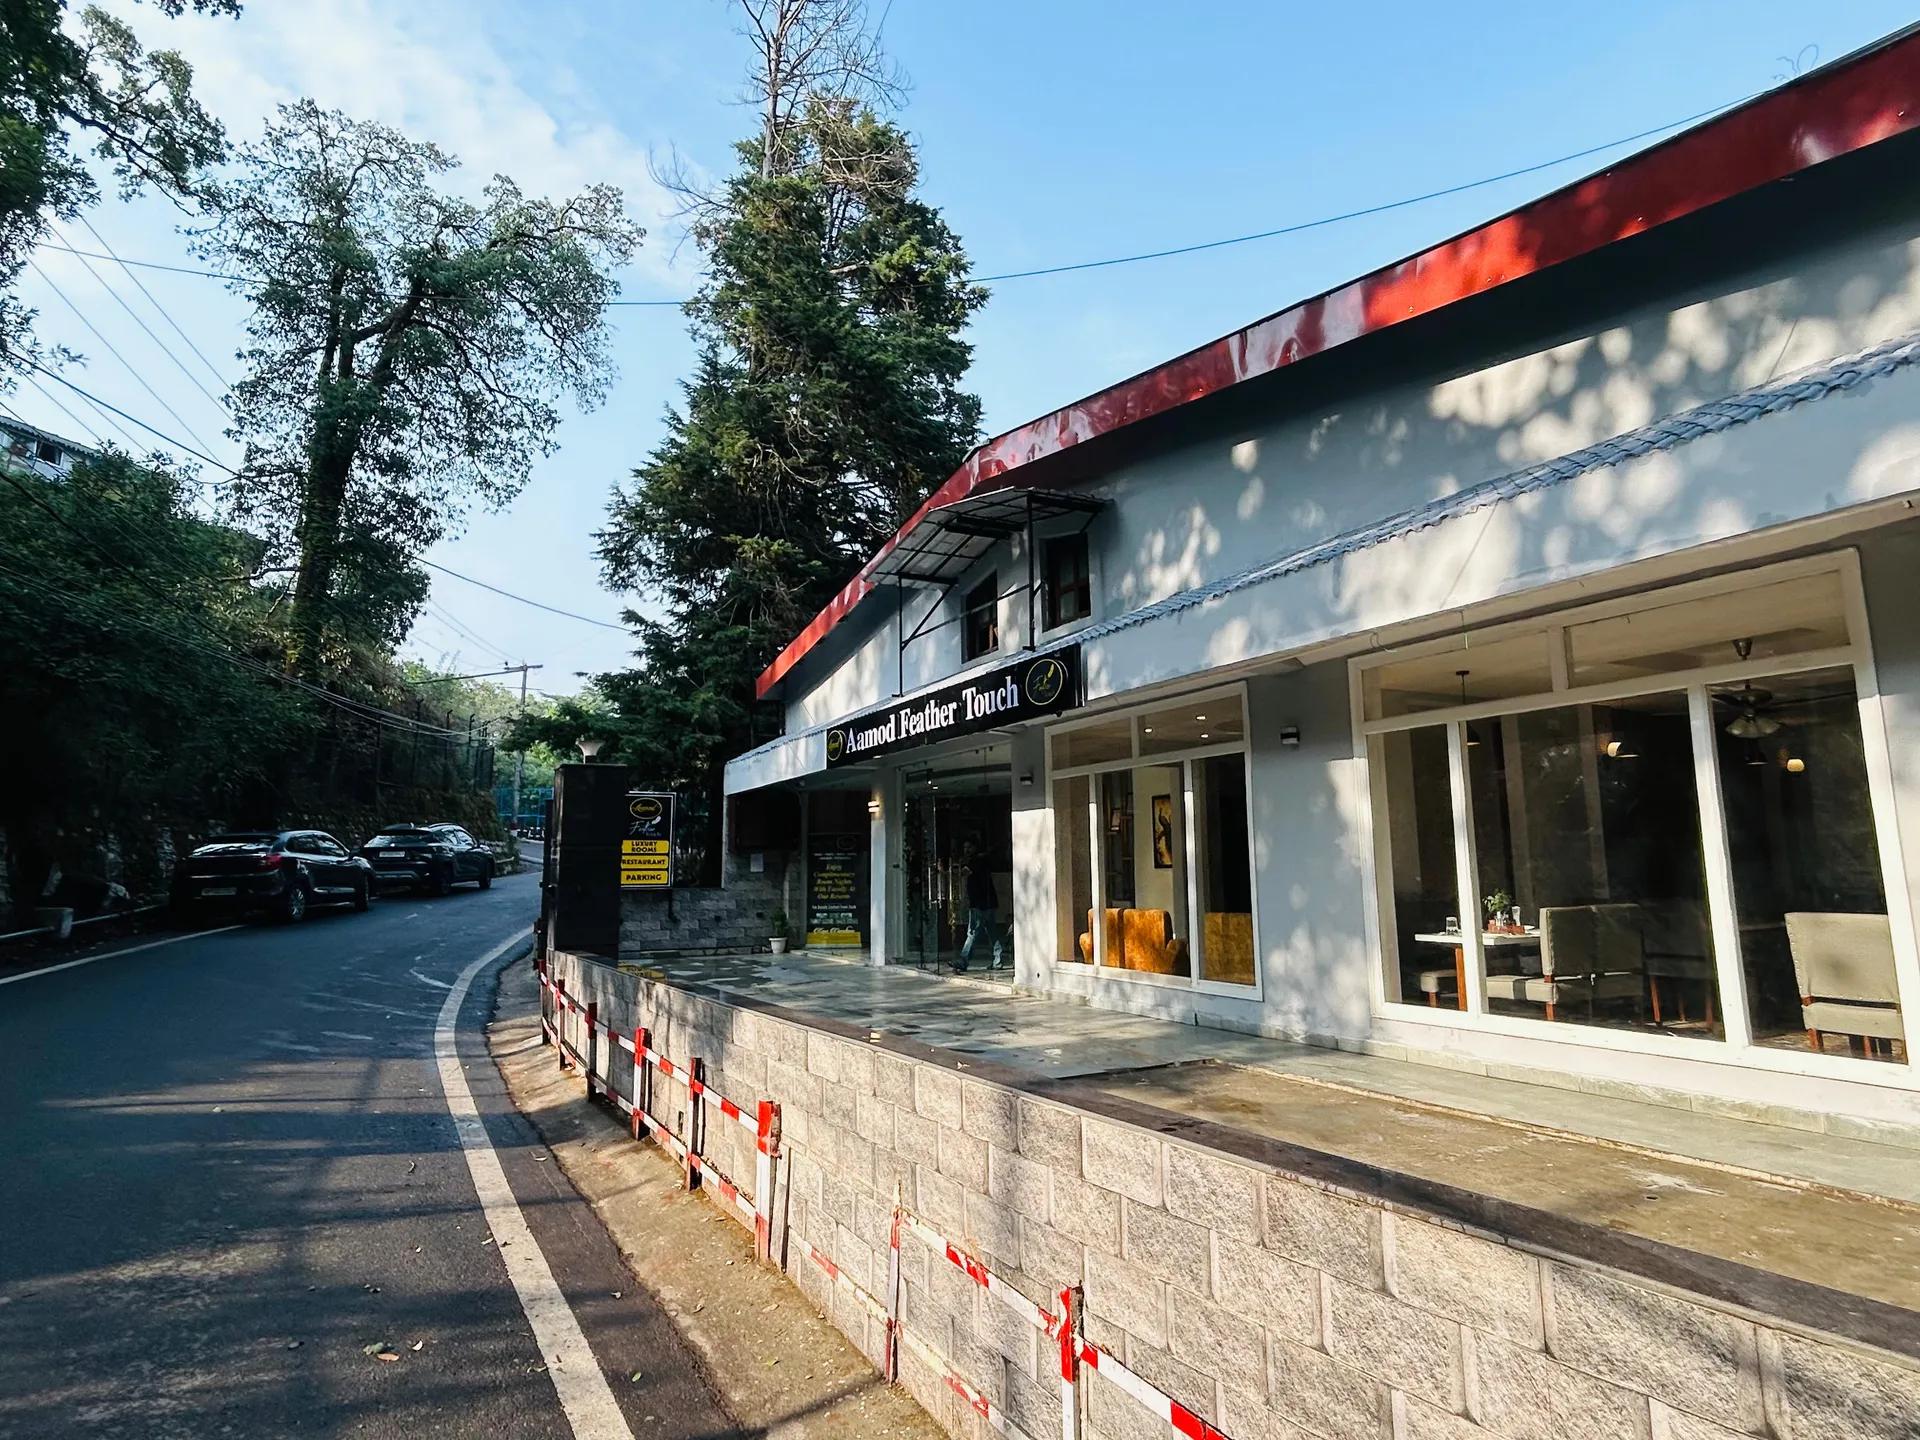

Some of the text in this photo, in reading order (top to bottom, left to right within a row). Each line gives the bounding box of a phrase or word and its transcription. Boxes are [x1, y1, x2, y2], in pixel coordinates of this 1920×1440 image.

[846, 715, 896, 753] Aamod
[898, 700, 957, 738] Feather
[962, 676, 1019, 720] Touch
